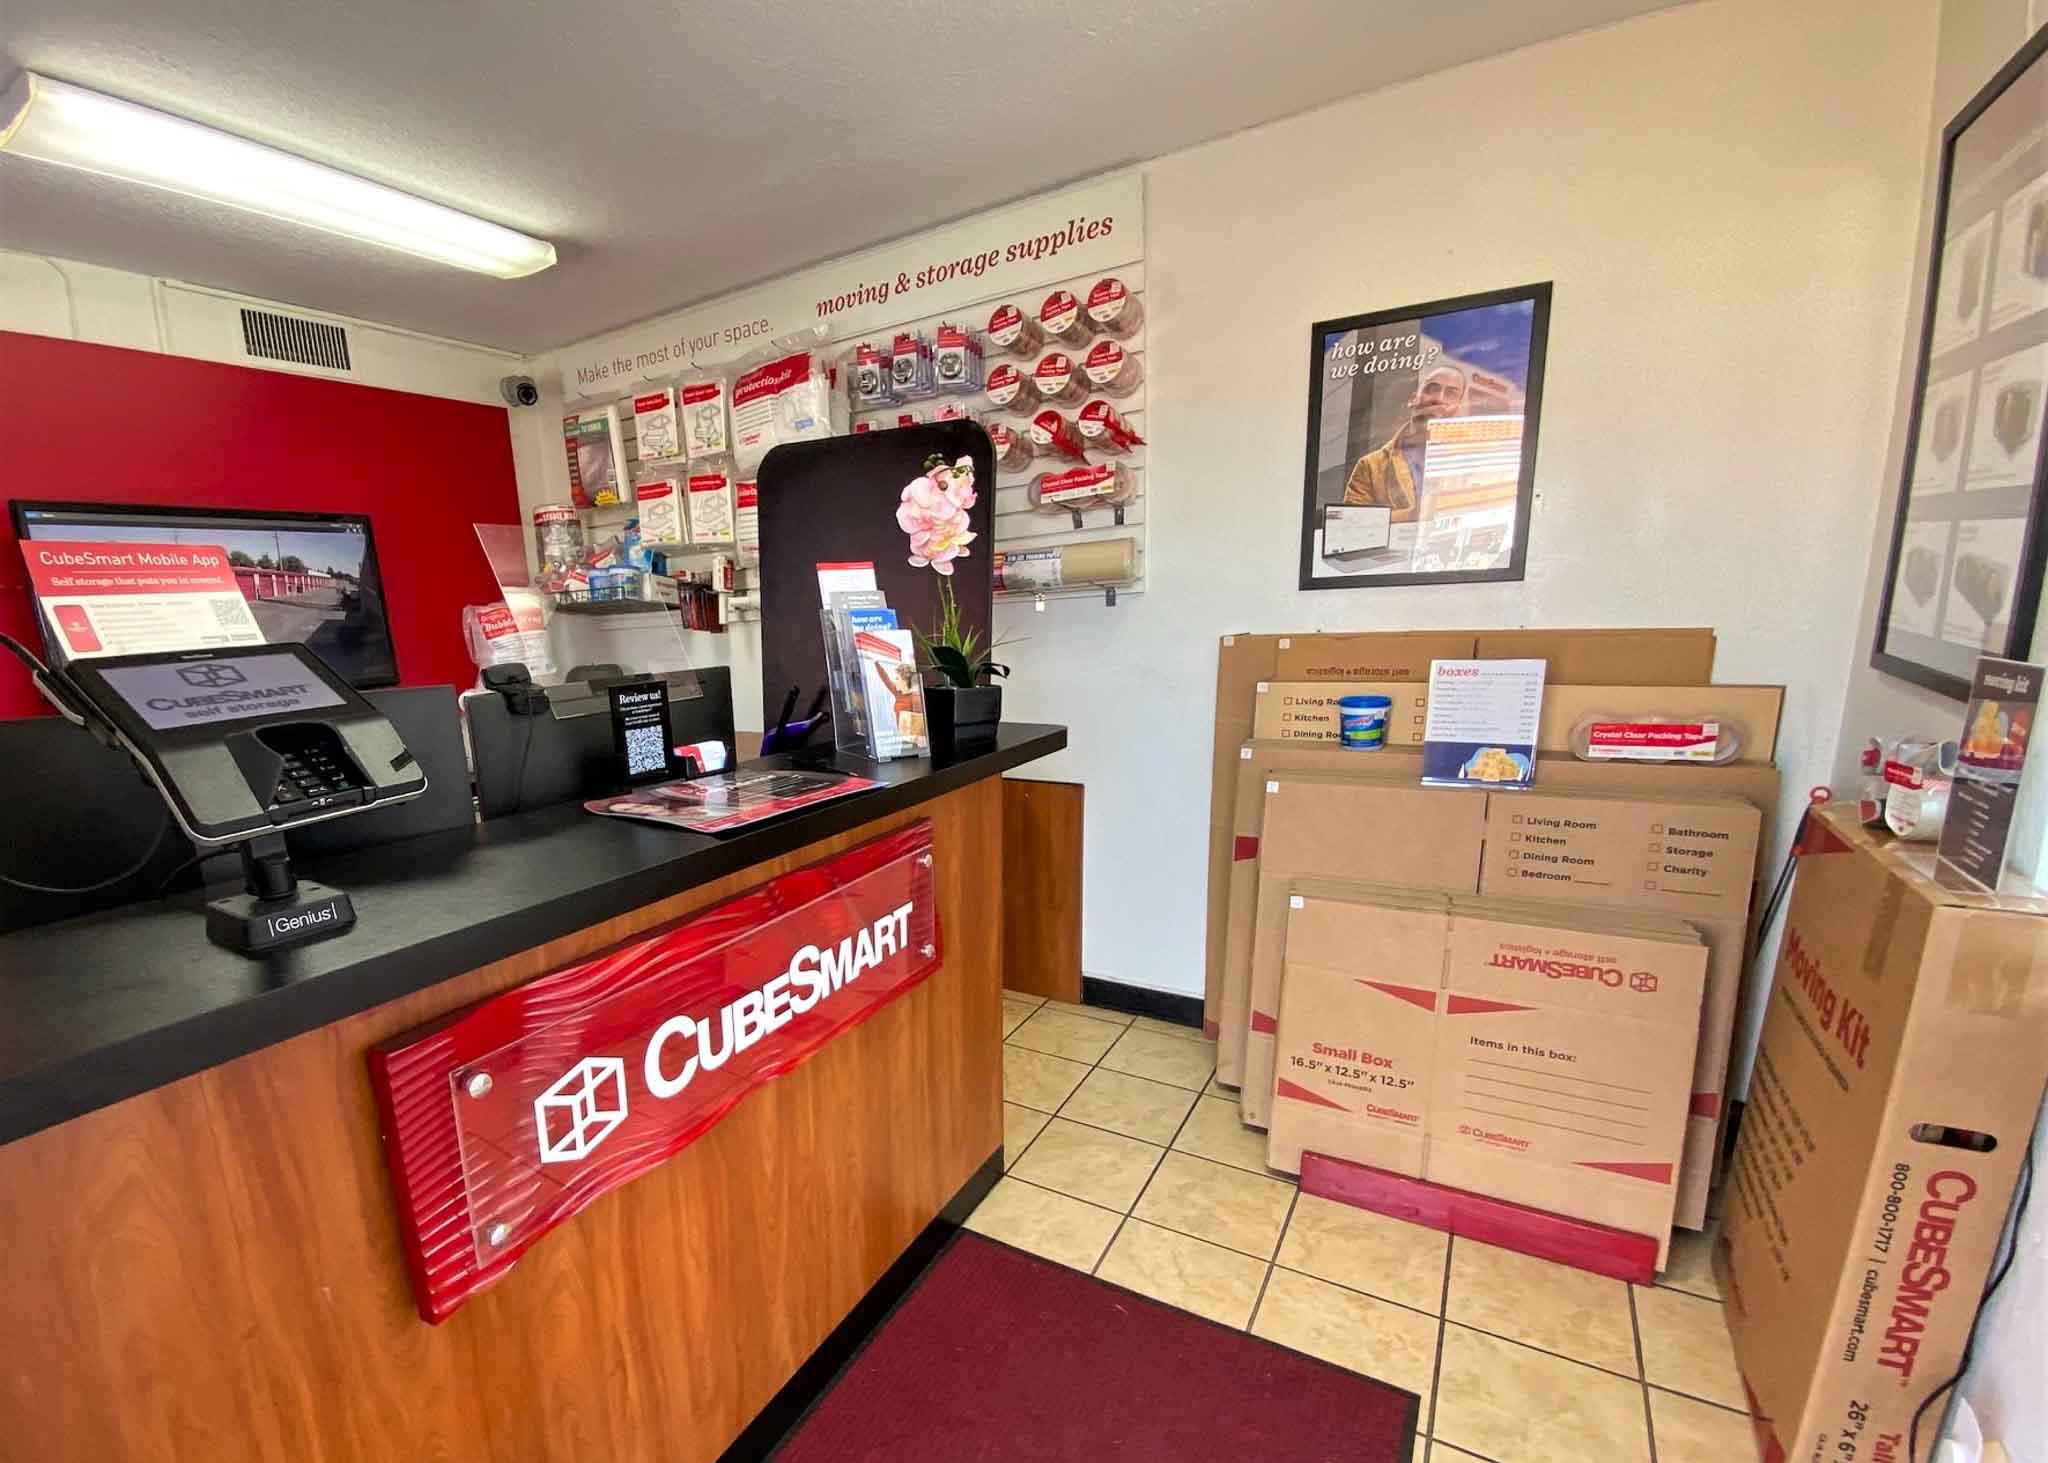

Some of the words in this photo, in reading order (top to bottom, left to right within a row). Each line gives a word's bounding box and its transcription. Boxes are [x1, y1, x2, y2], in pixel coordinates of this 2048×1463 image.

[816, 281, 890, 317] moving
[894, 273, 910, 294] &
[916, 249, 999, 288] storage
[1006, 216, 1113, 263] supplies
[577, 368, 609, 384] Make
[612, 356, 632, 376] the
[636, 346, 670, 369] most
[673, 337, 686, 357] of
[688, 331, 720, 360] your
[724, 317, 774, 346] space.
[1331, 341, 1375, 360] how
[1380, 334, 1417, 352] are
[1330, 362, 1359, 379] we
[1364, 346, 1440, 374] doing?
[40, 551, 134, 566] CubeSmart
[138, 552, 187, 566] Mobile
[192, 553, 219, 569] App
[51, 577, 75, 586] Self
[76, 577, 113, 587] storage
[115, 575, 136, 586] that
[1437, 665, 1480, 677] boxes
[619, 692, 649, 705] Review
[1295, 698, 1324, 706] Living
[185, 707, 222, 719] self
[228, 699, 299, 714] storage
[1294, 714, 1330, 722] Kitchen
[1293, 731, 1323, 739] Dining
[1624, 731, 1646, 739] Clear
[1648, 731, 1681, 740] Packing
[1527, 816, 1560, 830] Living
[1563, 820, 1597, 830] Room
[1525, 835, 1567, 846] Kitchen
[1667, 827, 1730, 840] Bathroom
[1523, 852, 1559, 864] Dining
[1561, 855, 1595, 866] Room
[1665, 845, 1714, 859] Storage
[1521, 869, 1572, 882] Bedroom
[1663, 864, 1710, 878] Charity
[275, 907, 332, 934] Genius
[1552, 949, 1595, 962] storage
[1786, 928, 1836, 1031] Moving
[1836, 997, 1871, 1069] Kit
[1312, 1042, 1357, 1061] Small
[1361, 1052, 1393, 1069] Box
[1470, 1036, 1504, 1049] Items
[1507, 1043, 1518, 1052] in
[1522, 1045, 1545, 1057] this
[1549, 1050, 1577, 1062] box:
[1324, 1064, 1332, 1073] x
[1370, 1074, 1377, 1083] x
[1874, 1162, 1911, 1256] 800-800-1717
[1842, 1267, 1879, 1363] cubesmart.com
[1843, 1429, 1856, 1440] x
